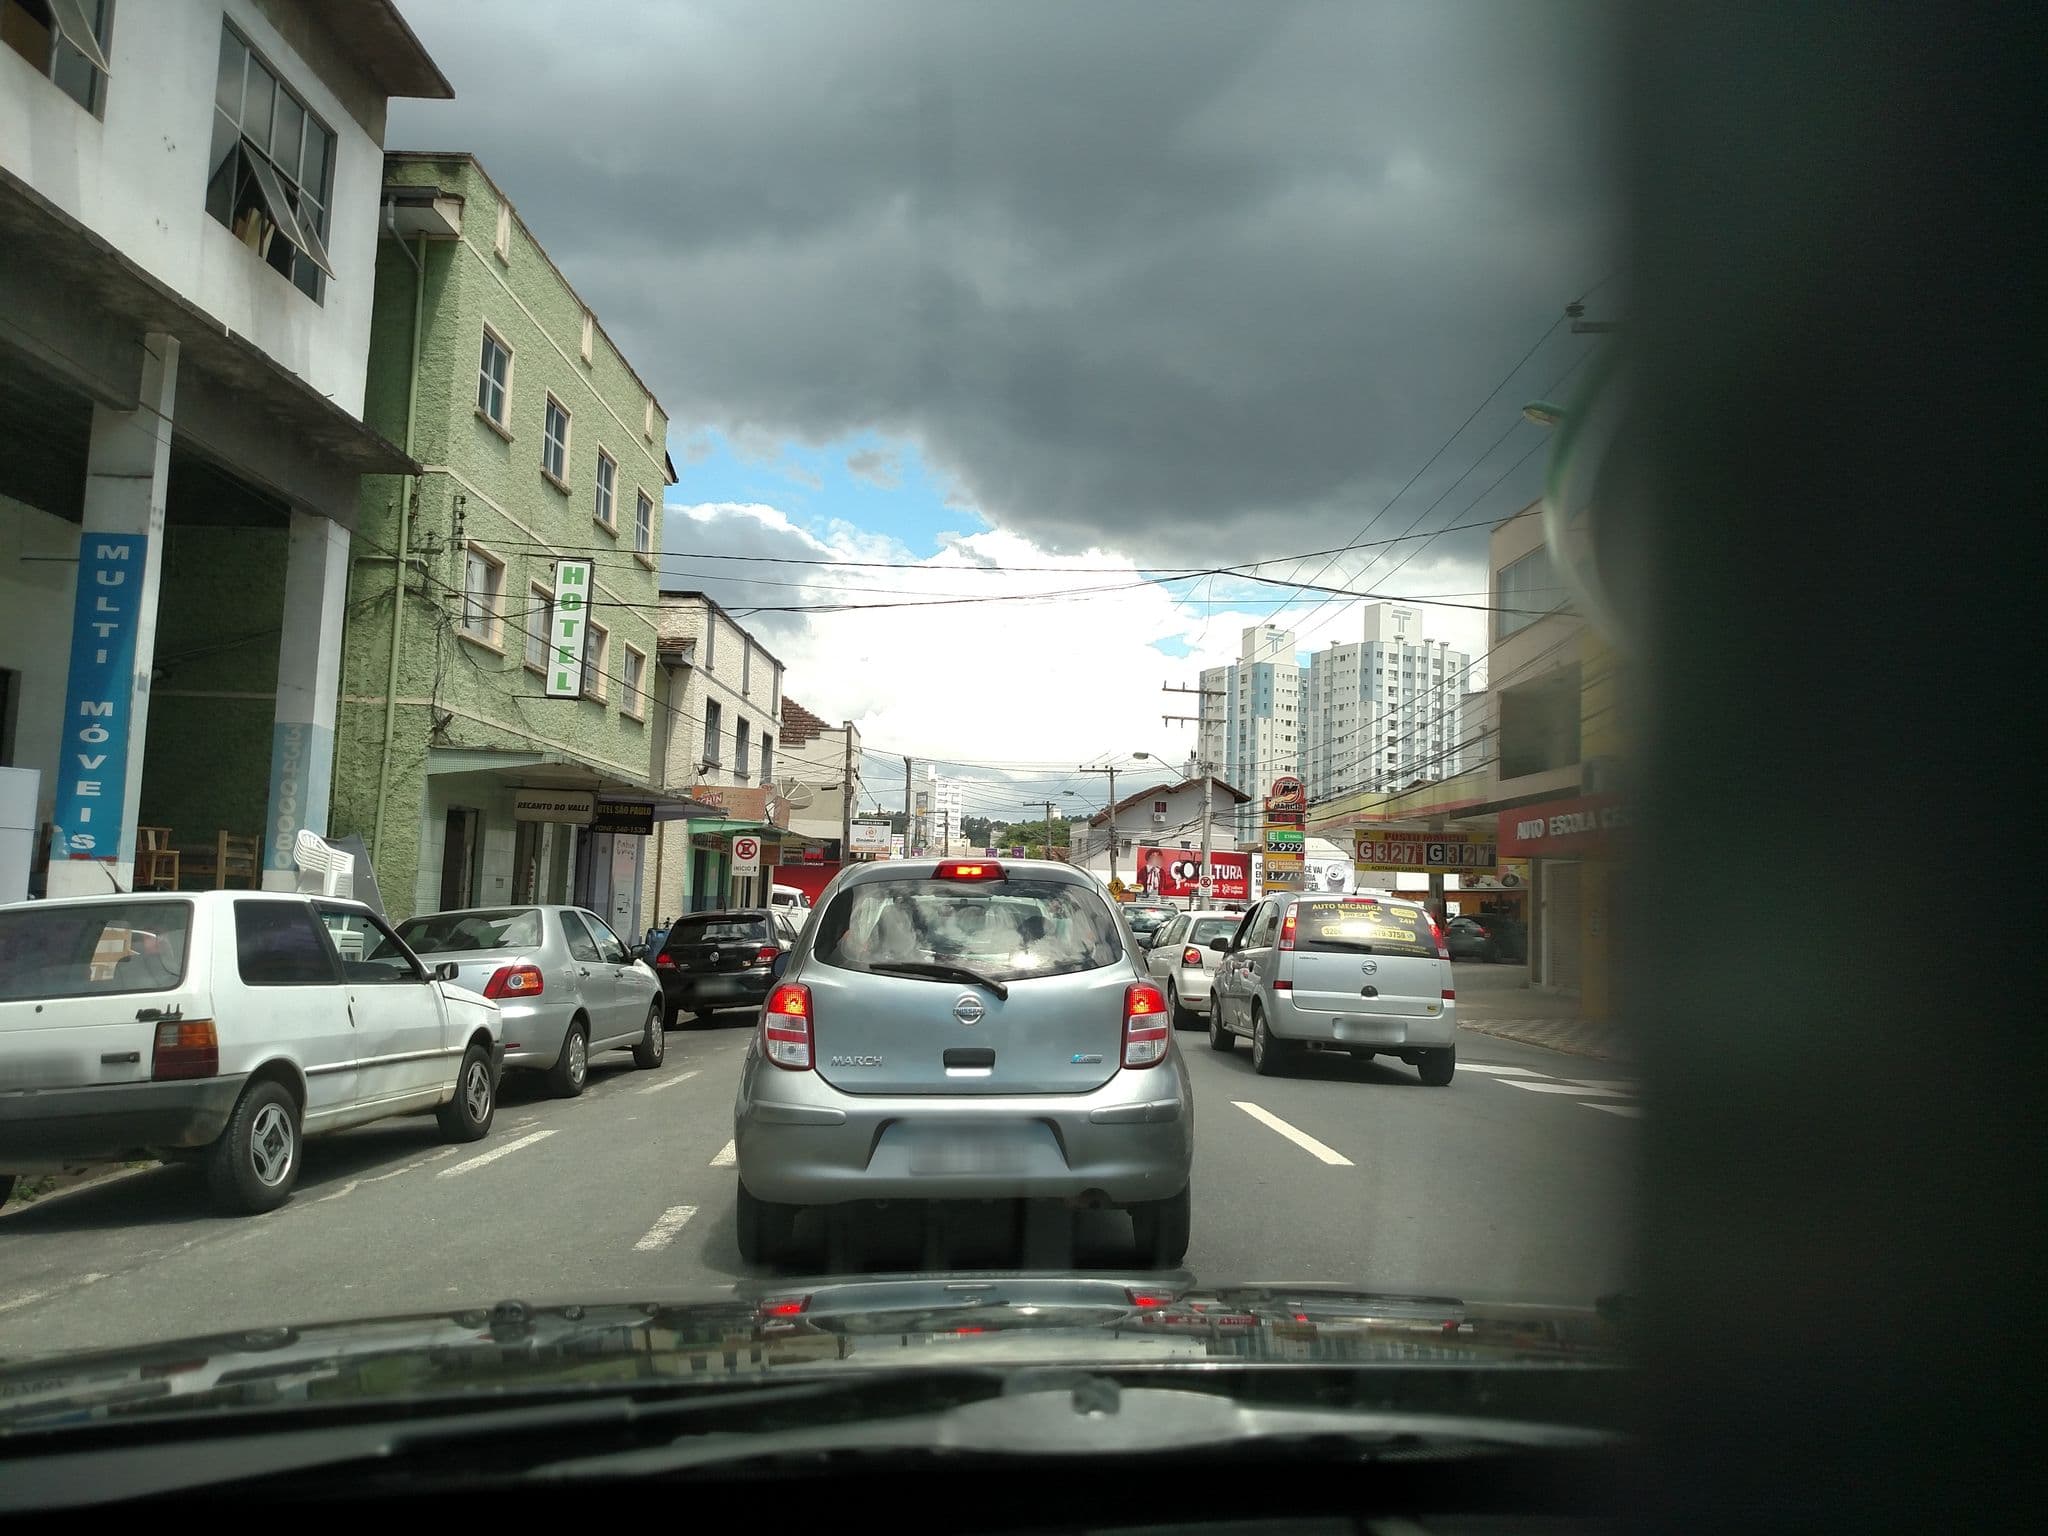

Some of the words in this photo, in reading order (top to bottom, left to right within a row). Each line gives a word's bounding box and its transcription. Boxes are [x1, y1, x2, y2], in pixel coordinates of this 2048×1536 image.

[92, 544, 130, 665] MULTI
[555, 566, 584, 692] HOTEL
[70, 700, 114, 850] MÓVEIS
[517, 801, 552, 811] RECANTO
[568, 804, 590, 812] VALLE
[629, 806, 652, 816] PAULO
[1517, 818, 1545, 840] AUTO
[1549, 811, 1596, 836] ESCOLA
[1360, 842, 1373, 858] G
[1430, 845, 1443, 861] G
[831, 1055, 883, 1067] MARCH
